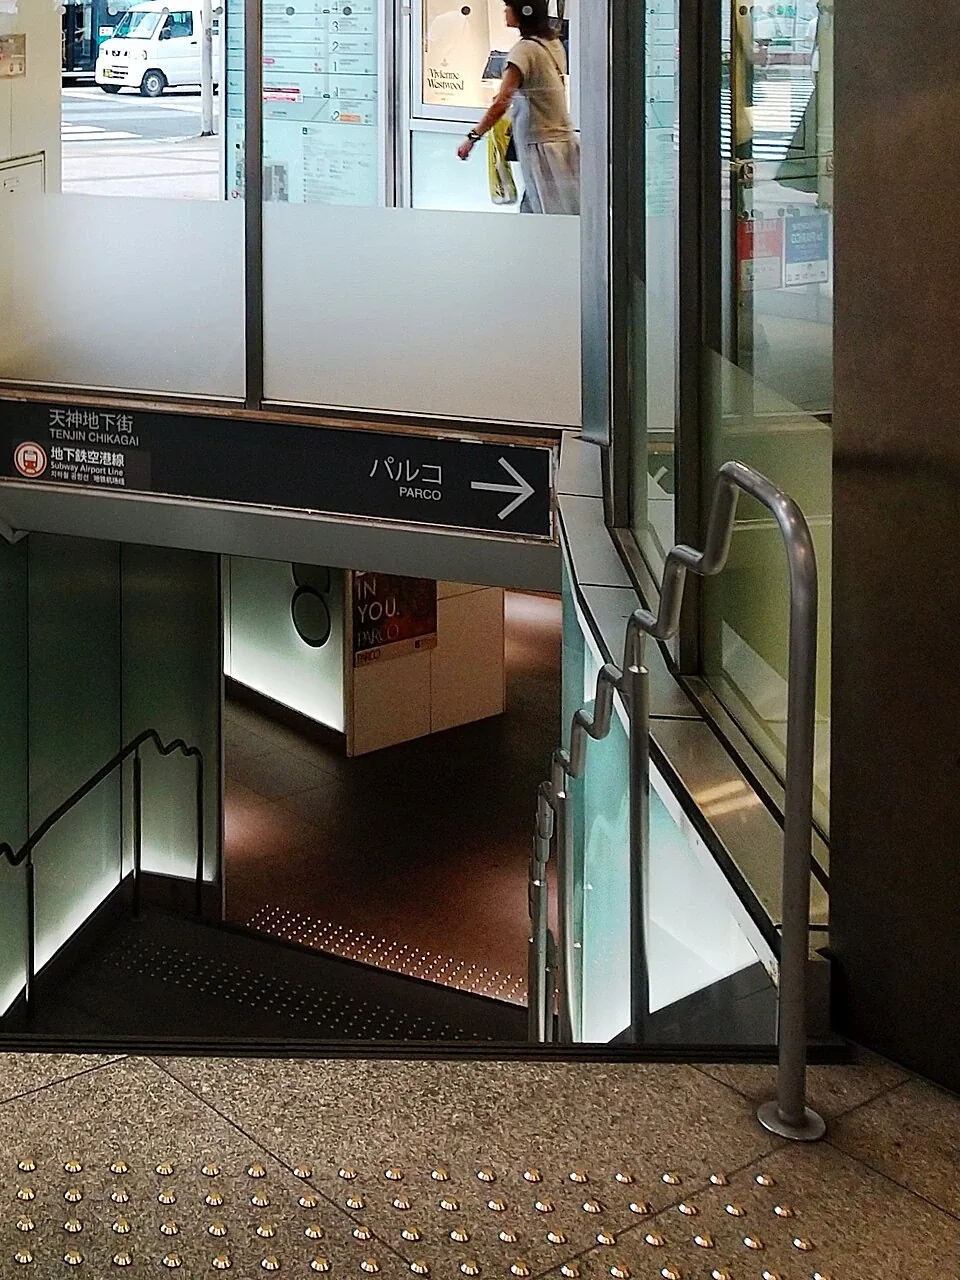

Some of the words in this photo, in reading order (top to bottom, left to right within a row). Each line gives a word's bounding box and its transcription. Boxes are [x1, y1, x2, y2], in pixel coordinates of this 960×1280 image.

[49, 409, 133, 433] 天神地下街
[49, 428, 86, 441] TENJIN
[88, 432, 139, 446] CHIKAGAI
[51, 446, 125, 467] 地下鉄空港線
[51, 461, 79, 472] Subway
[80, 464, 107, 474] Airport
[107, 467, 124, 477] Line
[369, 456, 442, 484] パルコ
[399, 486, 442, 500] PARCO
[358, 578, 376, 600] IN
[357, 596, 400, 623] YOU.
